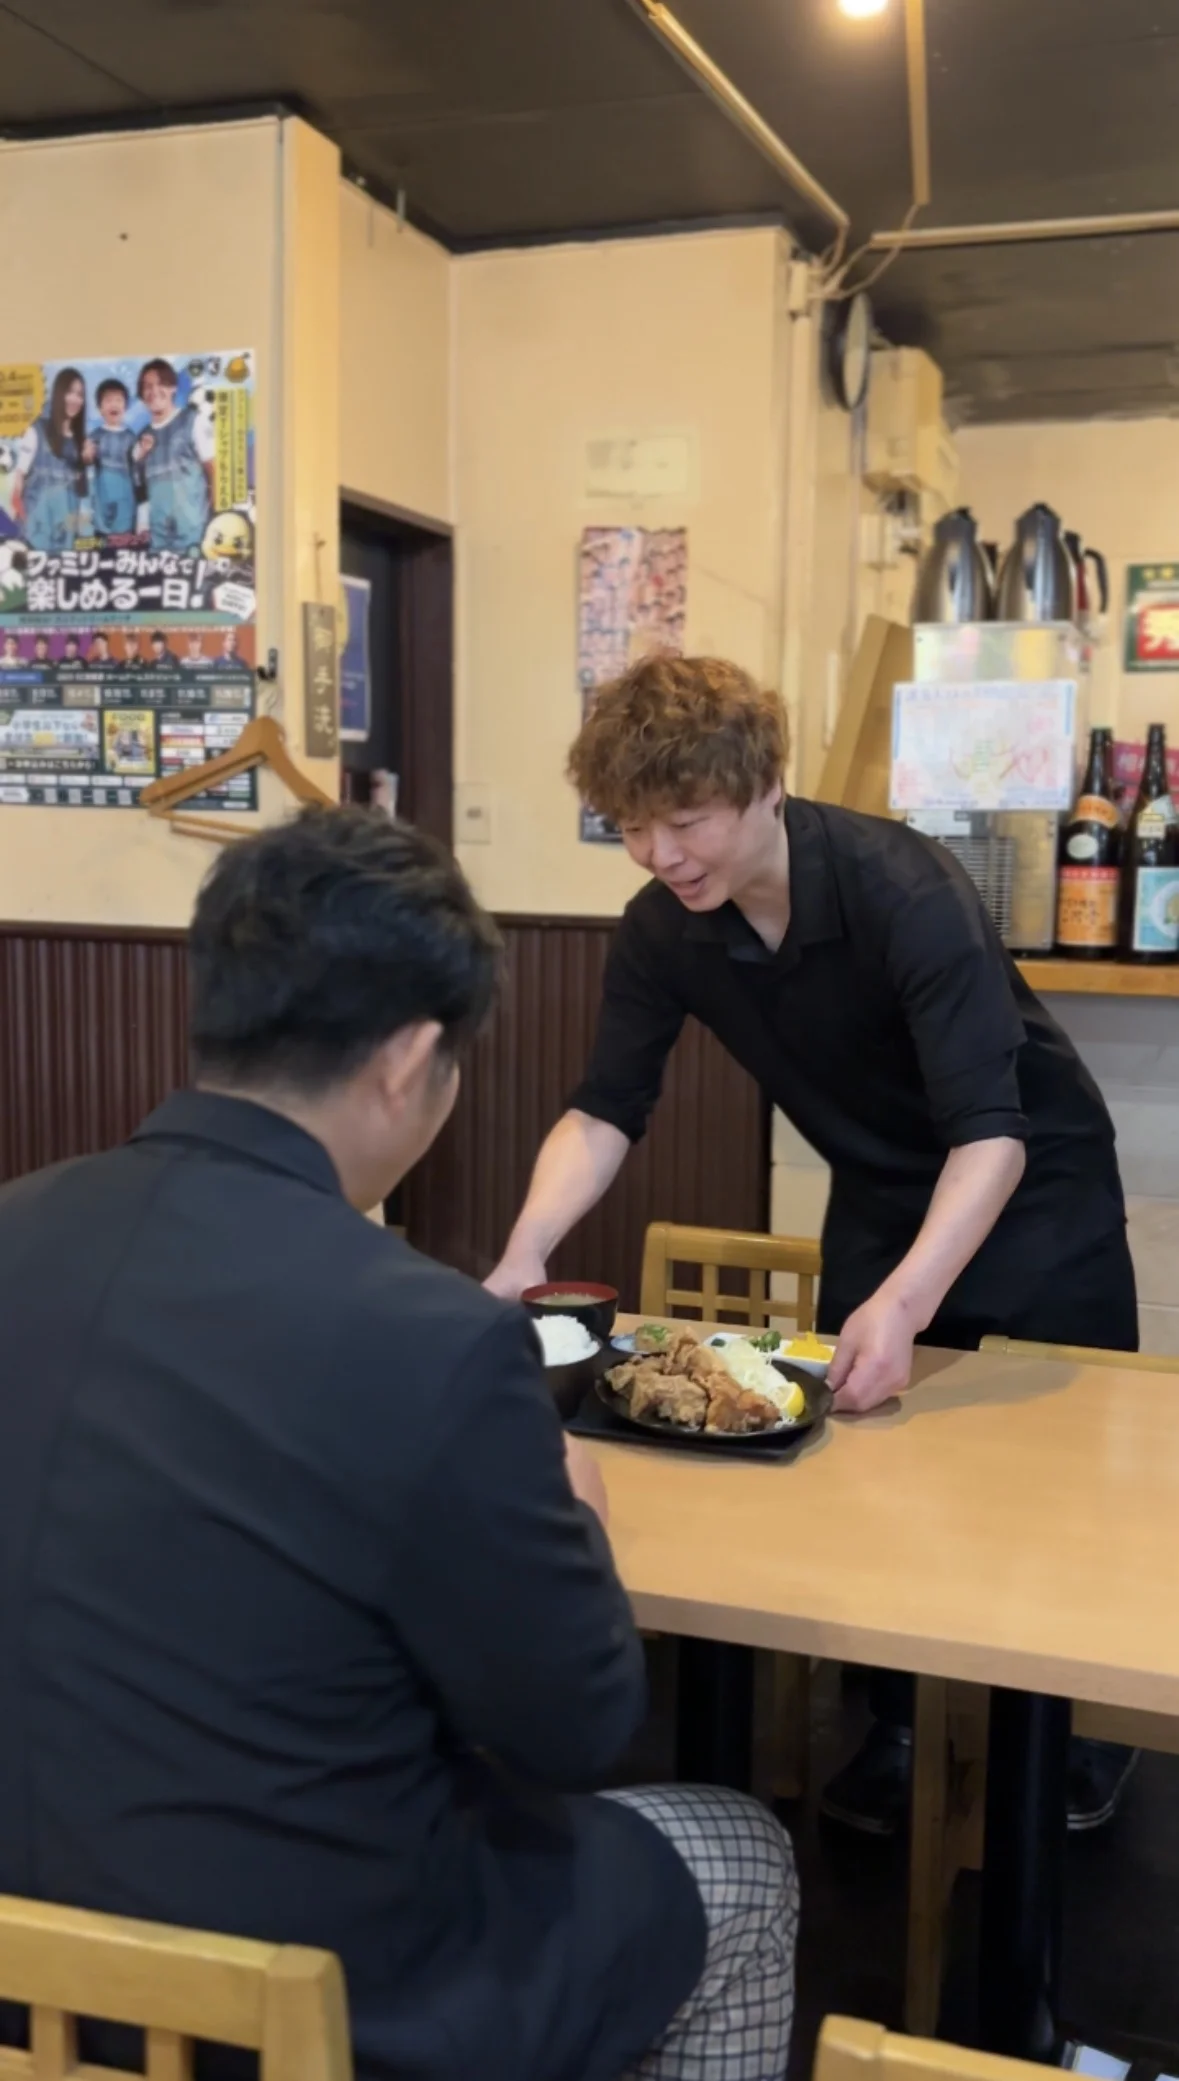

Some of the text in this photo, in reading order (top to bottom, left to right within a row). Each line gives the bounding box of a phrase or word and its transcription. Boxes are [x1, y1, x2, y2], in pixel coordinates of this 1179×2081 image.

[27, 549, 194, 576] ファミリーみんなで
[27, 560, 206, 611] 楽しめる一日!
